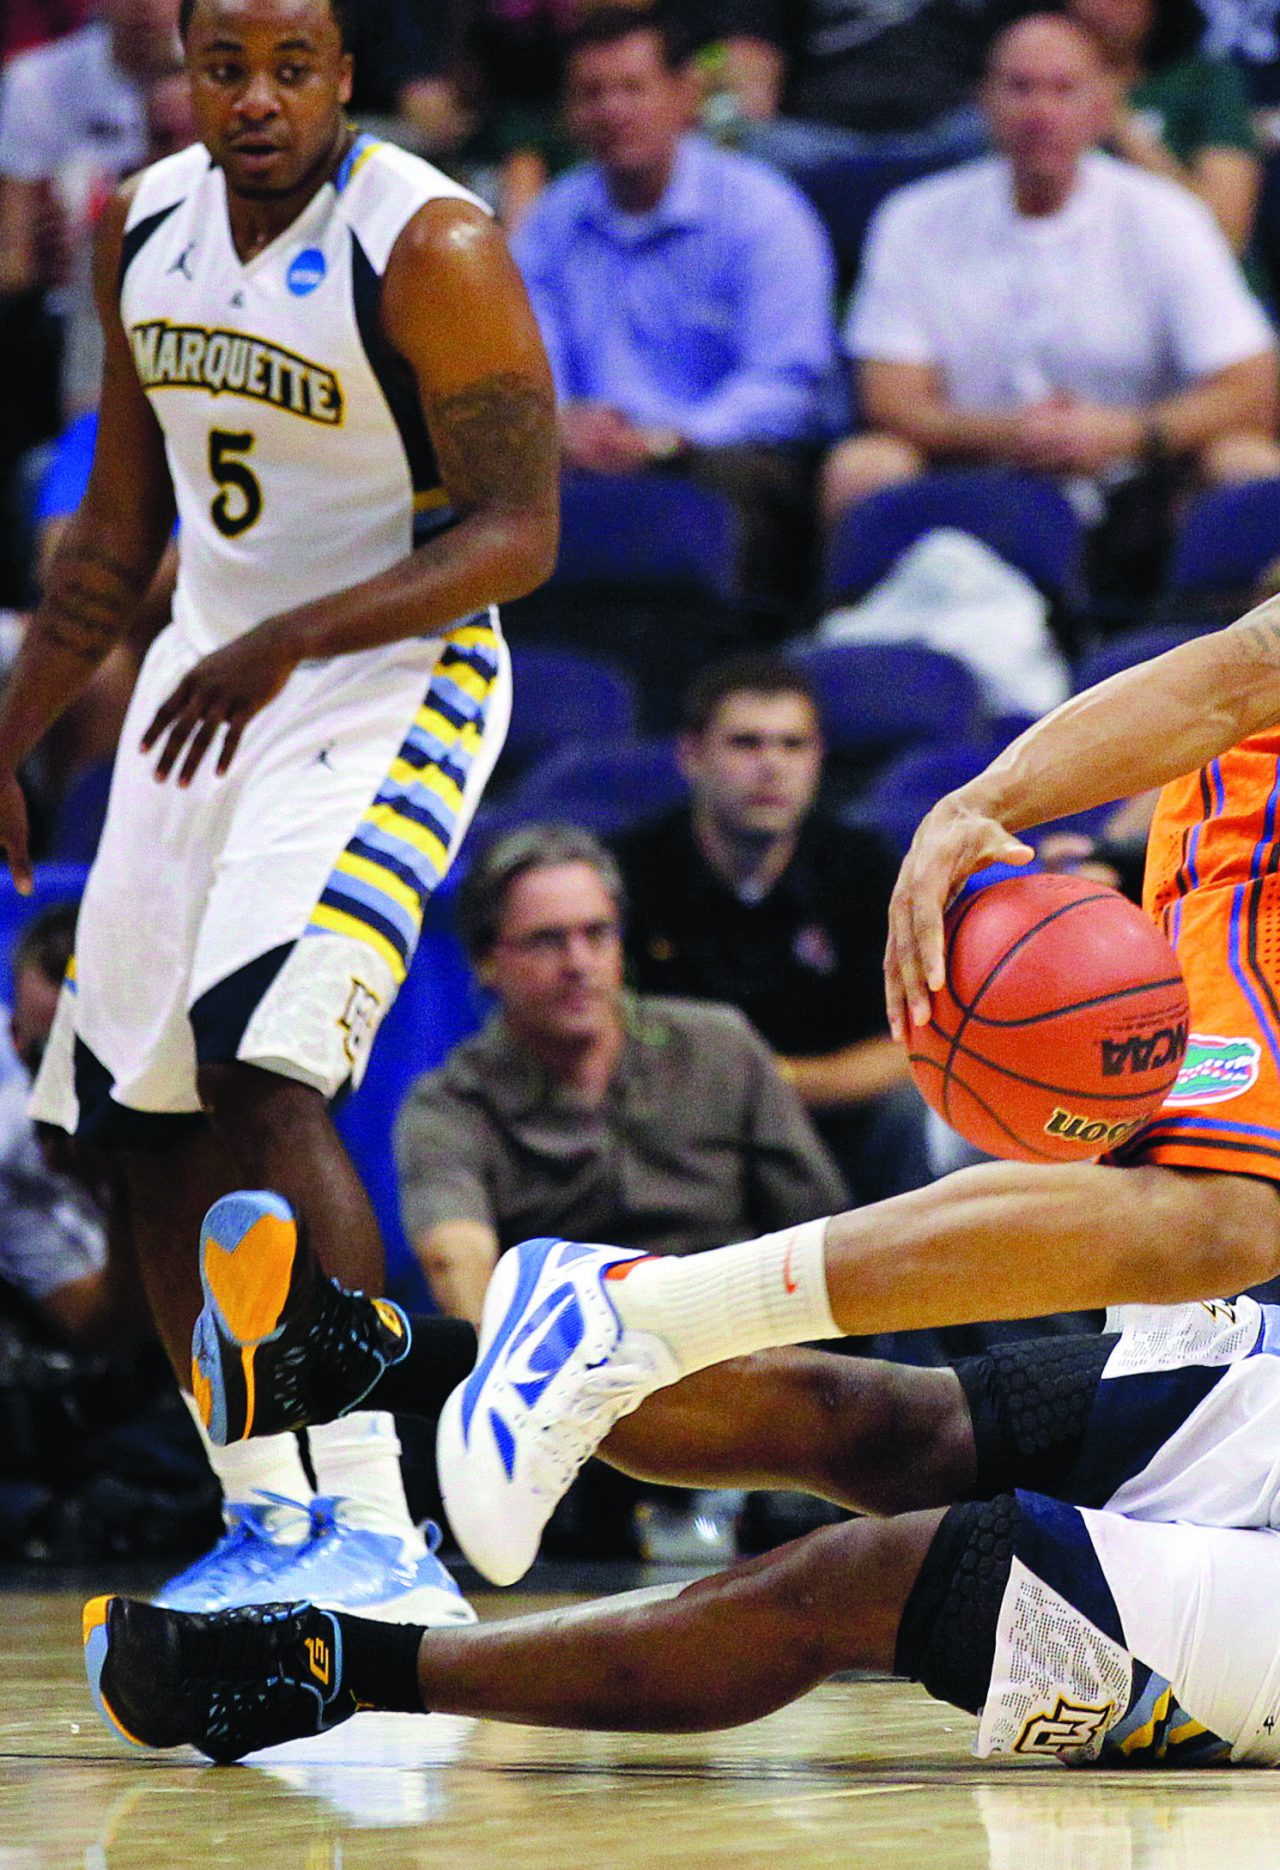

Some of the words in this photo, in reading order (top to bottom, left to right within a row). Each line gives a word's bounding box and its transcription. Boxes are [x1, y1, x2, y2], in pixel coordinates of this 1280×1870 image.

[130, 322, 341, 421] MARQUETTE
[210, 428, 263, 539] 5
[1043, 1106, 1140, 1143] son
